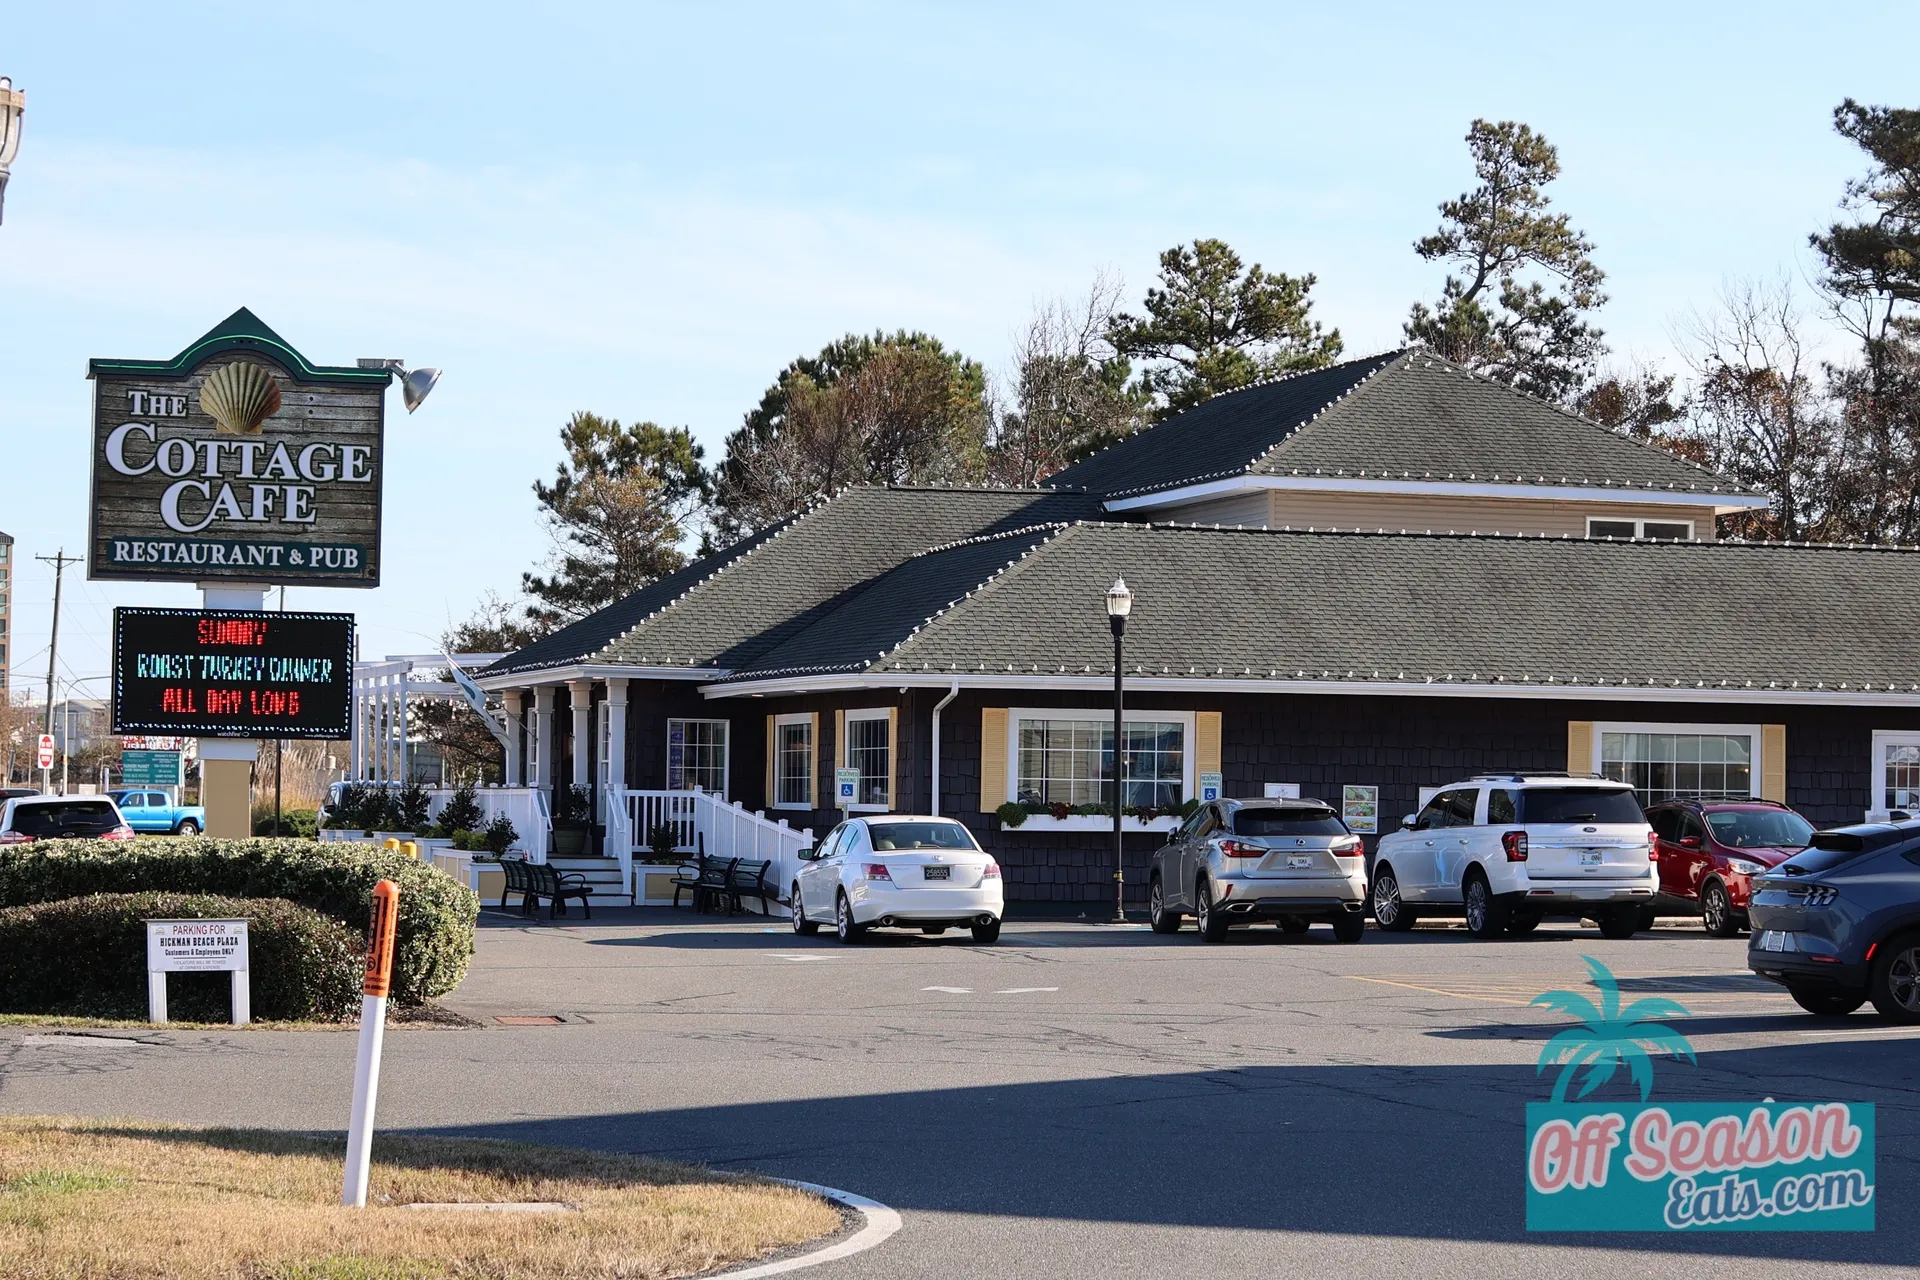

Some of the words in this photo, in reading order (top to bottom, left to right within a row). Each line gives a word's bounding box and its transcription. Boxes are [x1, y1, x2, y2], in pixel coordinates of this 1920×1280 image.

[128, 390, 188, 417] THE
[105, 422, 373, 483] COTTAGE
[160, 480, 317, 533] CAFE
[113, 540, 284, 567] RESTAURANT
[288, 548, 304, 567] &
[308, 546, 360, 569] PUB
[199, 654, 266, 682] TURKEY
[269, 656, 333, 683] DINNER
[162, 688, 198, 713] ALL
[206, 689, 242, 714] DAY
[173, 925, 208, 935] PARKING
[209, 924, 226, 935] FOR
[193, 937, 215, 946] BEACH
[217, 936, 239, 946] PLAZA
[165, 948, 190, 956] Customers
[195, 948, 221, 957] Employees
